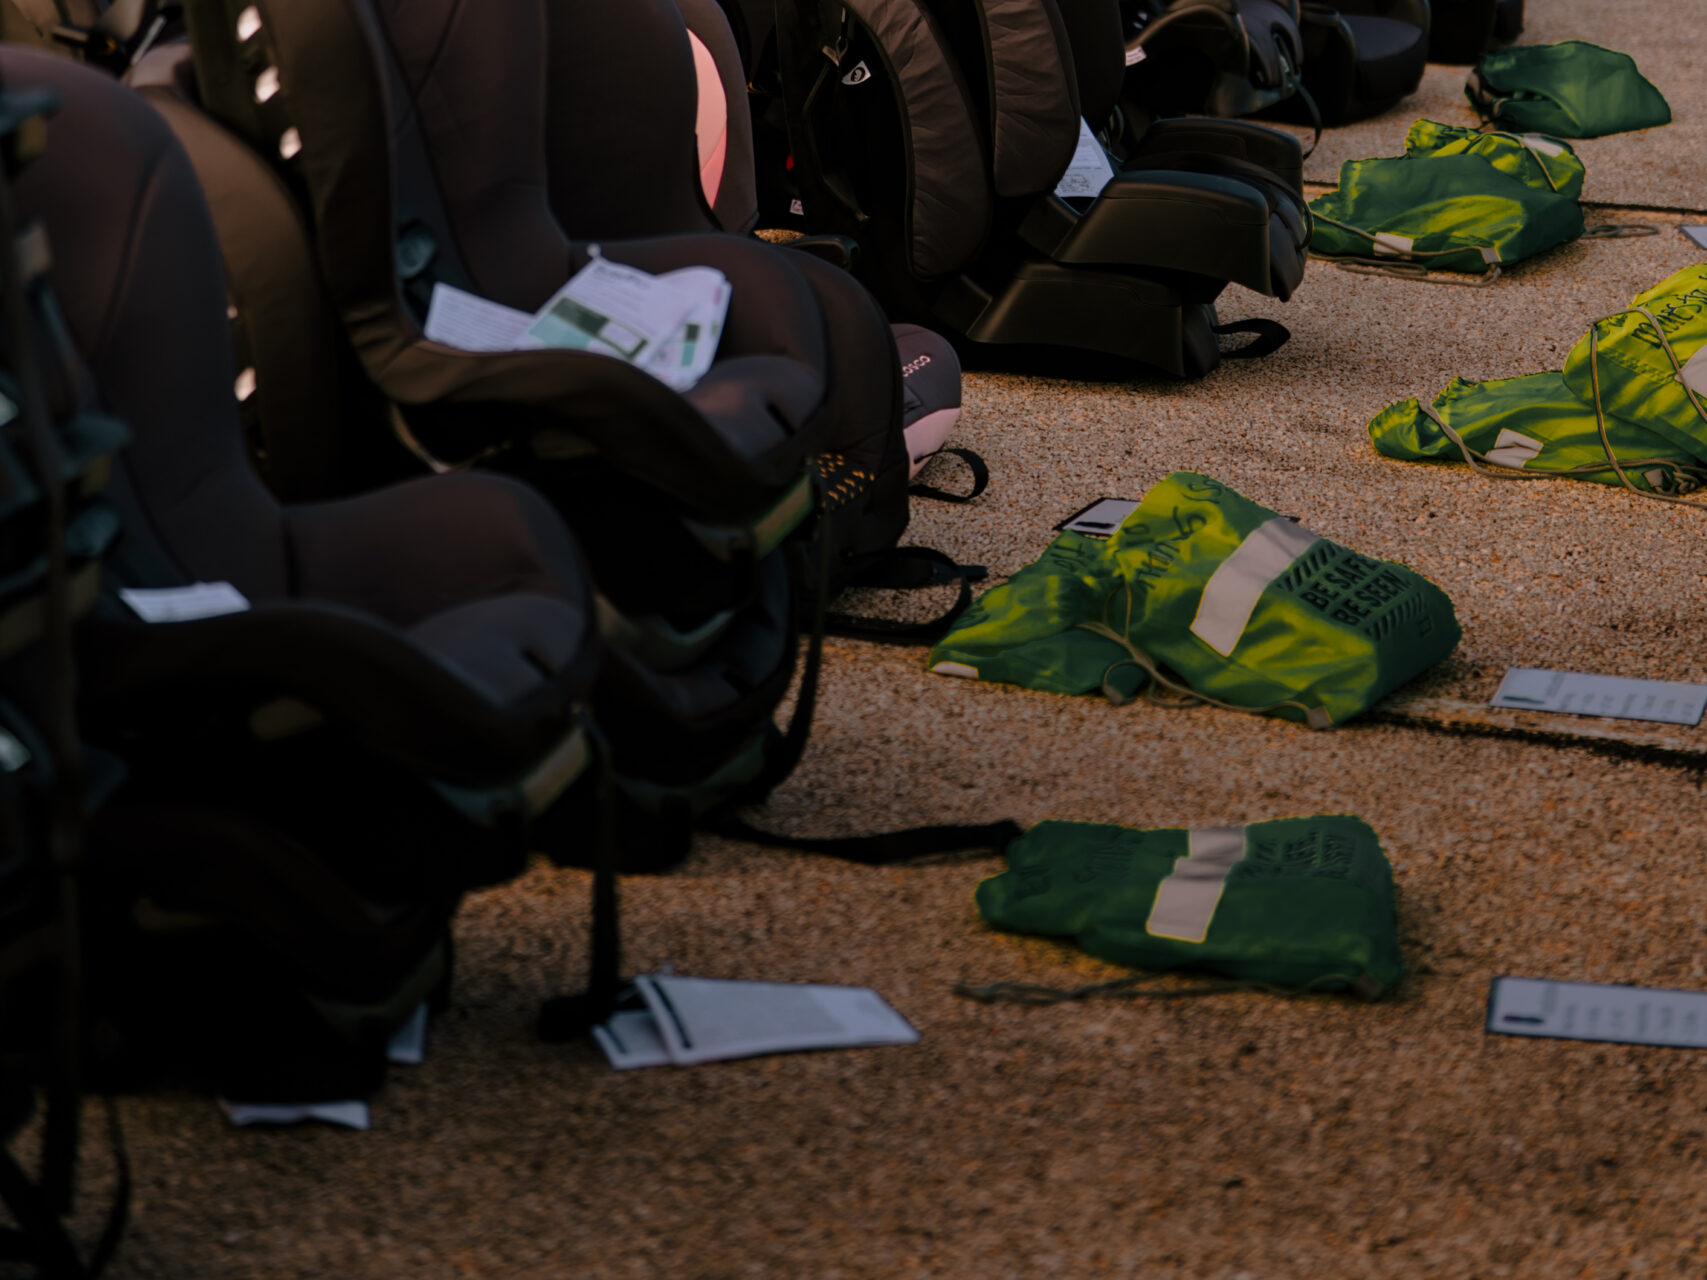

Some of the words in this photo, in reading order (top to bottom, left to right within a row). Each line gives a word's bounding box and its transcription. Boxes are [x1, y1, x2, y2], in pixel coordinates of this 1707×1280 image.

[1299, 582, 1339, 610] BE
[1324, 556, 1382, 591] SAFE
[1332, 599, 1371, 626] BE
